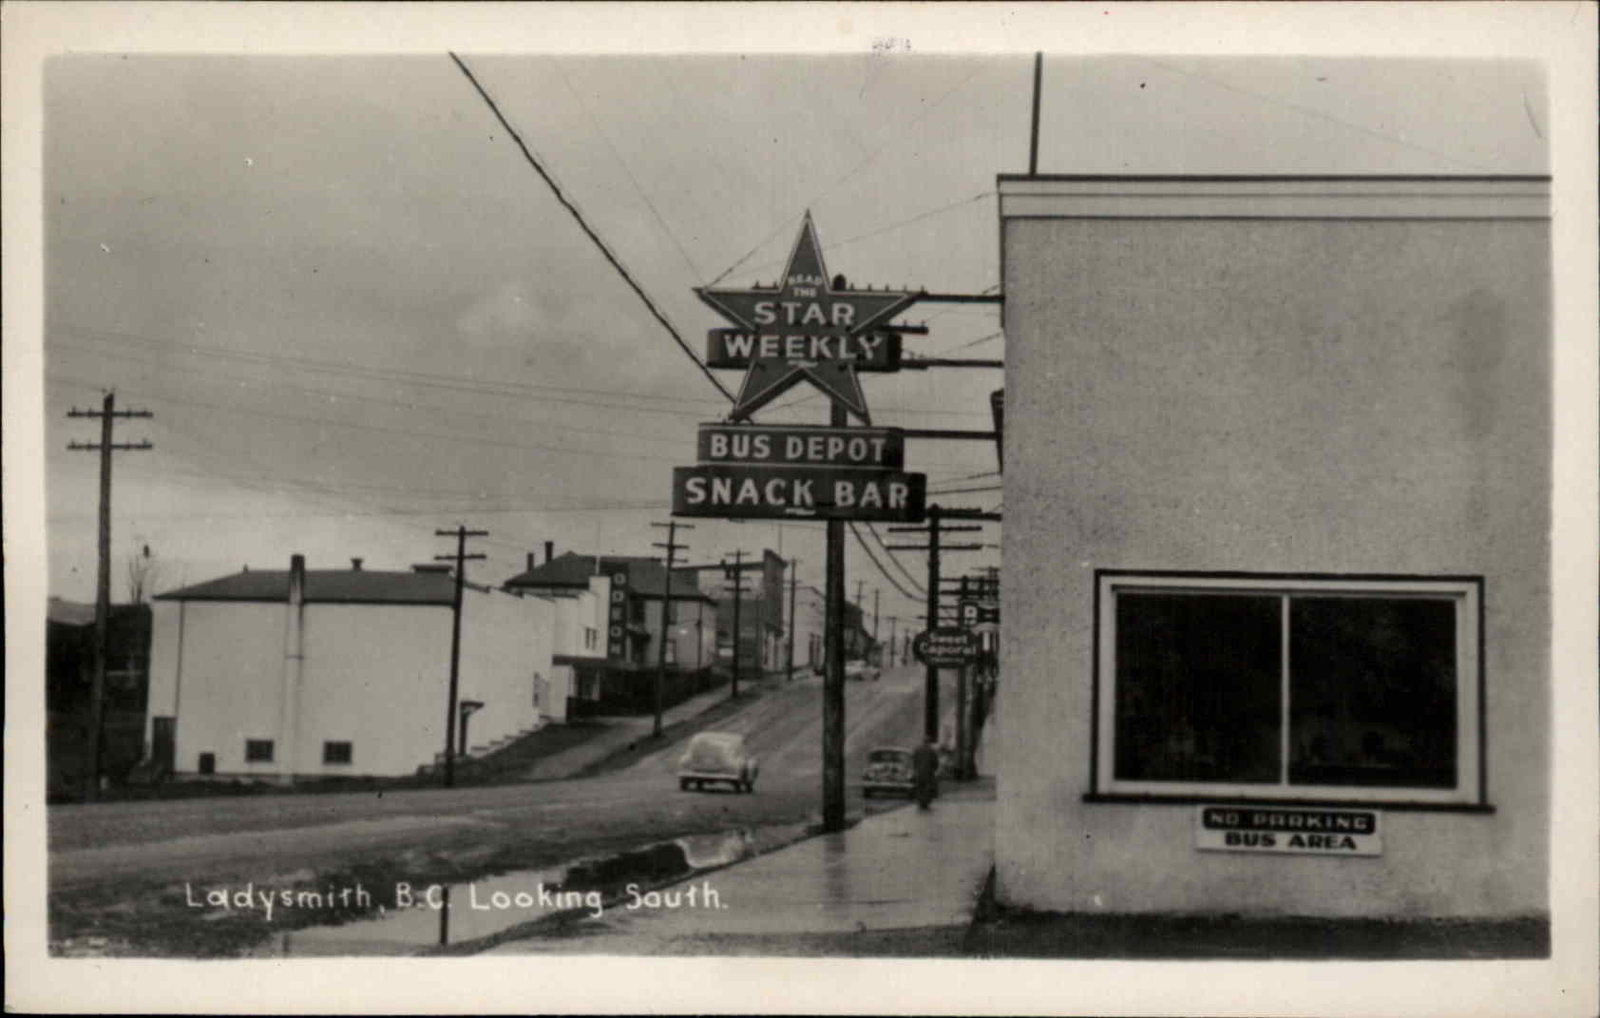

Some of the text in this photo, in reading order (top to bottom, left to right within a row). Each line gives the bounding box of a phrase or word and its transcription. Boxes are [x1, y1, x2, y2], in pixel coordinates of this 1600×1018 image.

[754, 302, 854, 325] STAR
[724, 335, 882, 359] WEEKLY
[710, 434, 886, 462] BUS DEPOT
[685, 477, 909, 509] SNACK BAR
[1211, 812, 1369, 830] NO PARKING
[1224, 832, 1357, 850] BUS AREA
